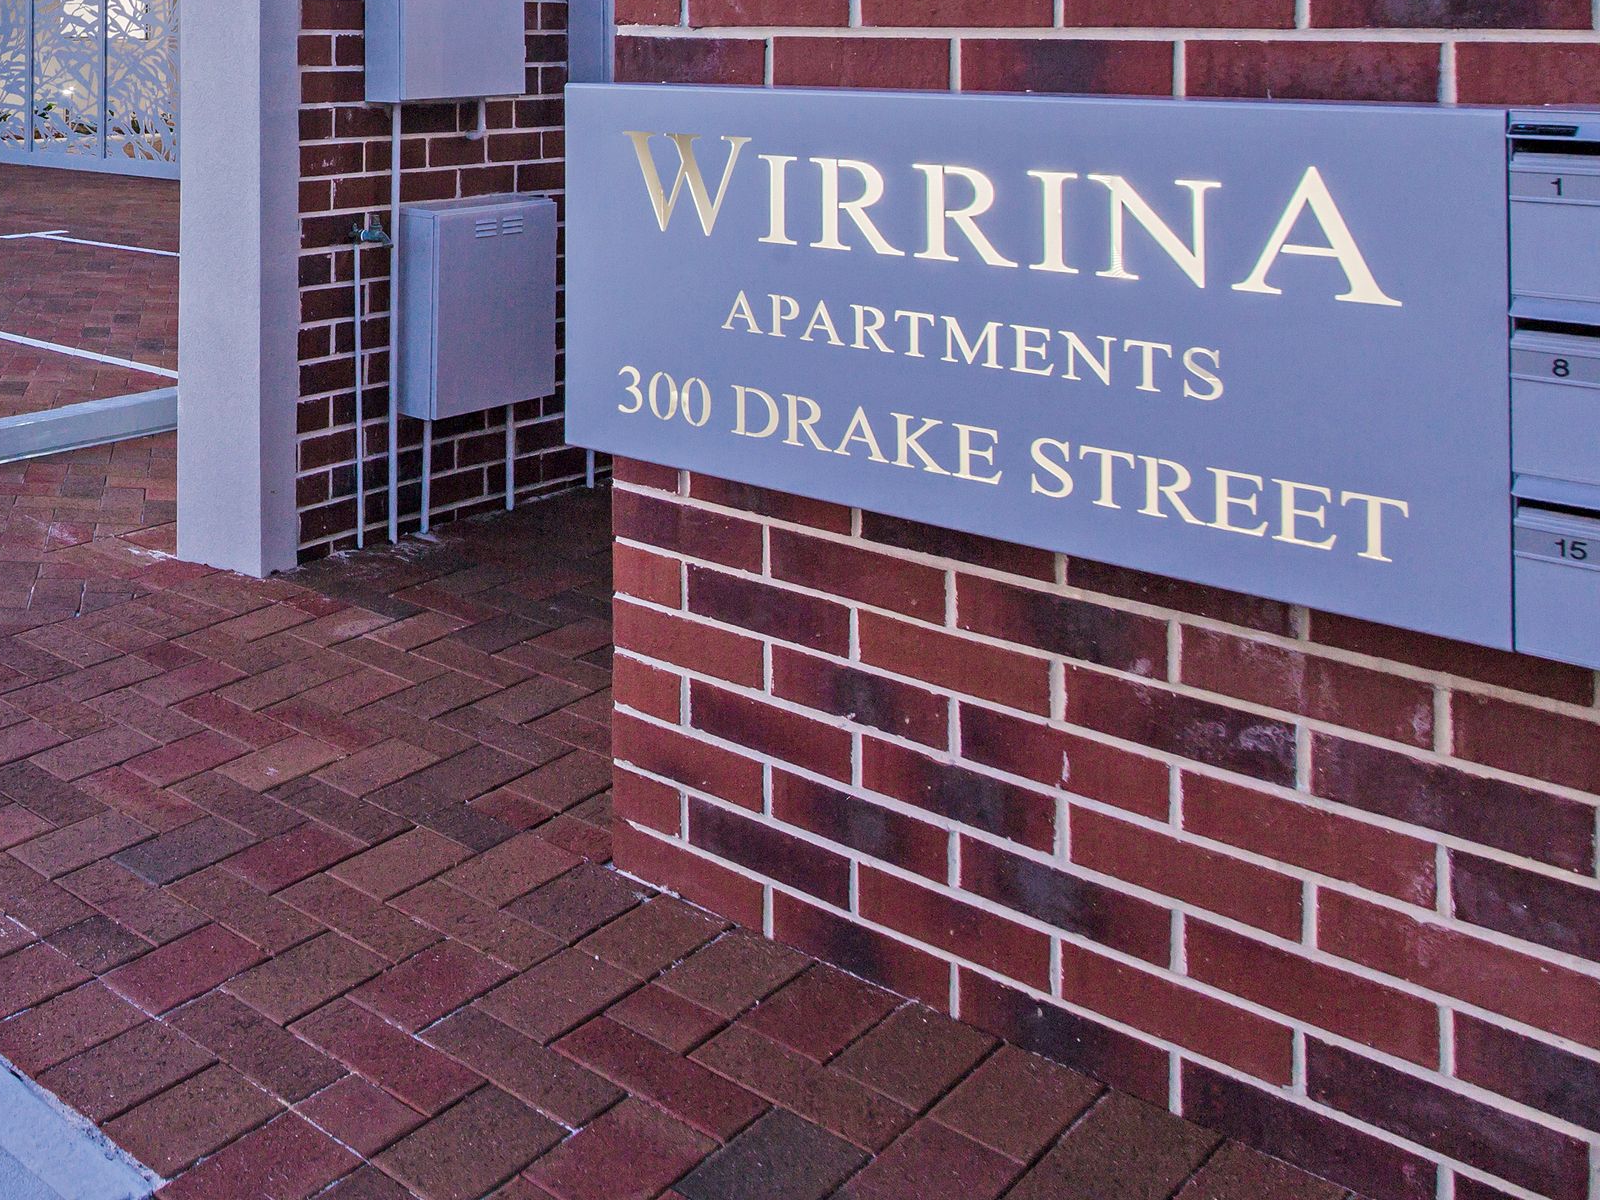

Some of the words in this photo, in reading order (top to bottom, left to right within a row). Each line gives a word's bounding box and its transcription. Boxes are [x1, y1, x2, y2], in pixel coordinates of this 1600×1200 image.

[623, 129, 1403, 308] WIRRINA
[1551, 176, 1564, 197] 1
[721, 290, 1226, 402] APARTMENTS
[1552, 359, 1571, 379] 8
[617, 364, 712, 427] 300
[731, 383, 1003, 486] DRAKE
[1030, 437, 1409, 564] STREET
[1554, 539, 1588, 561] 15
